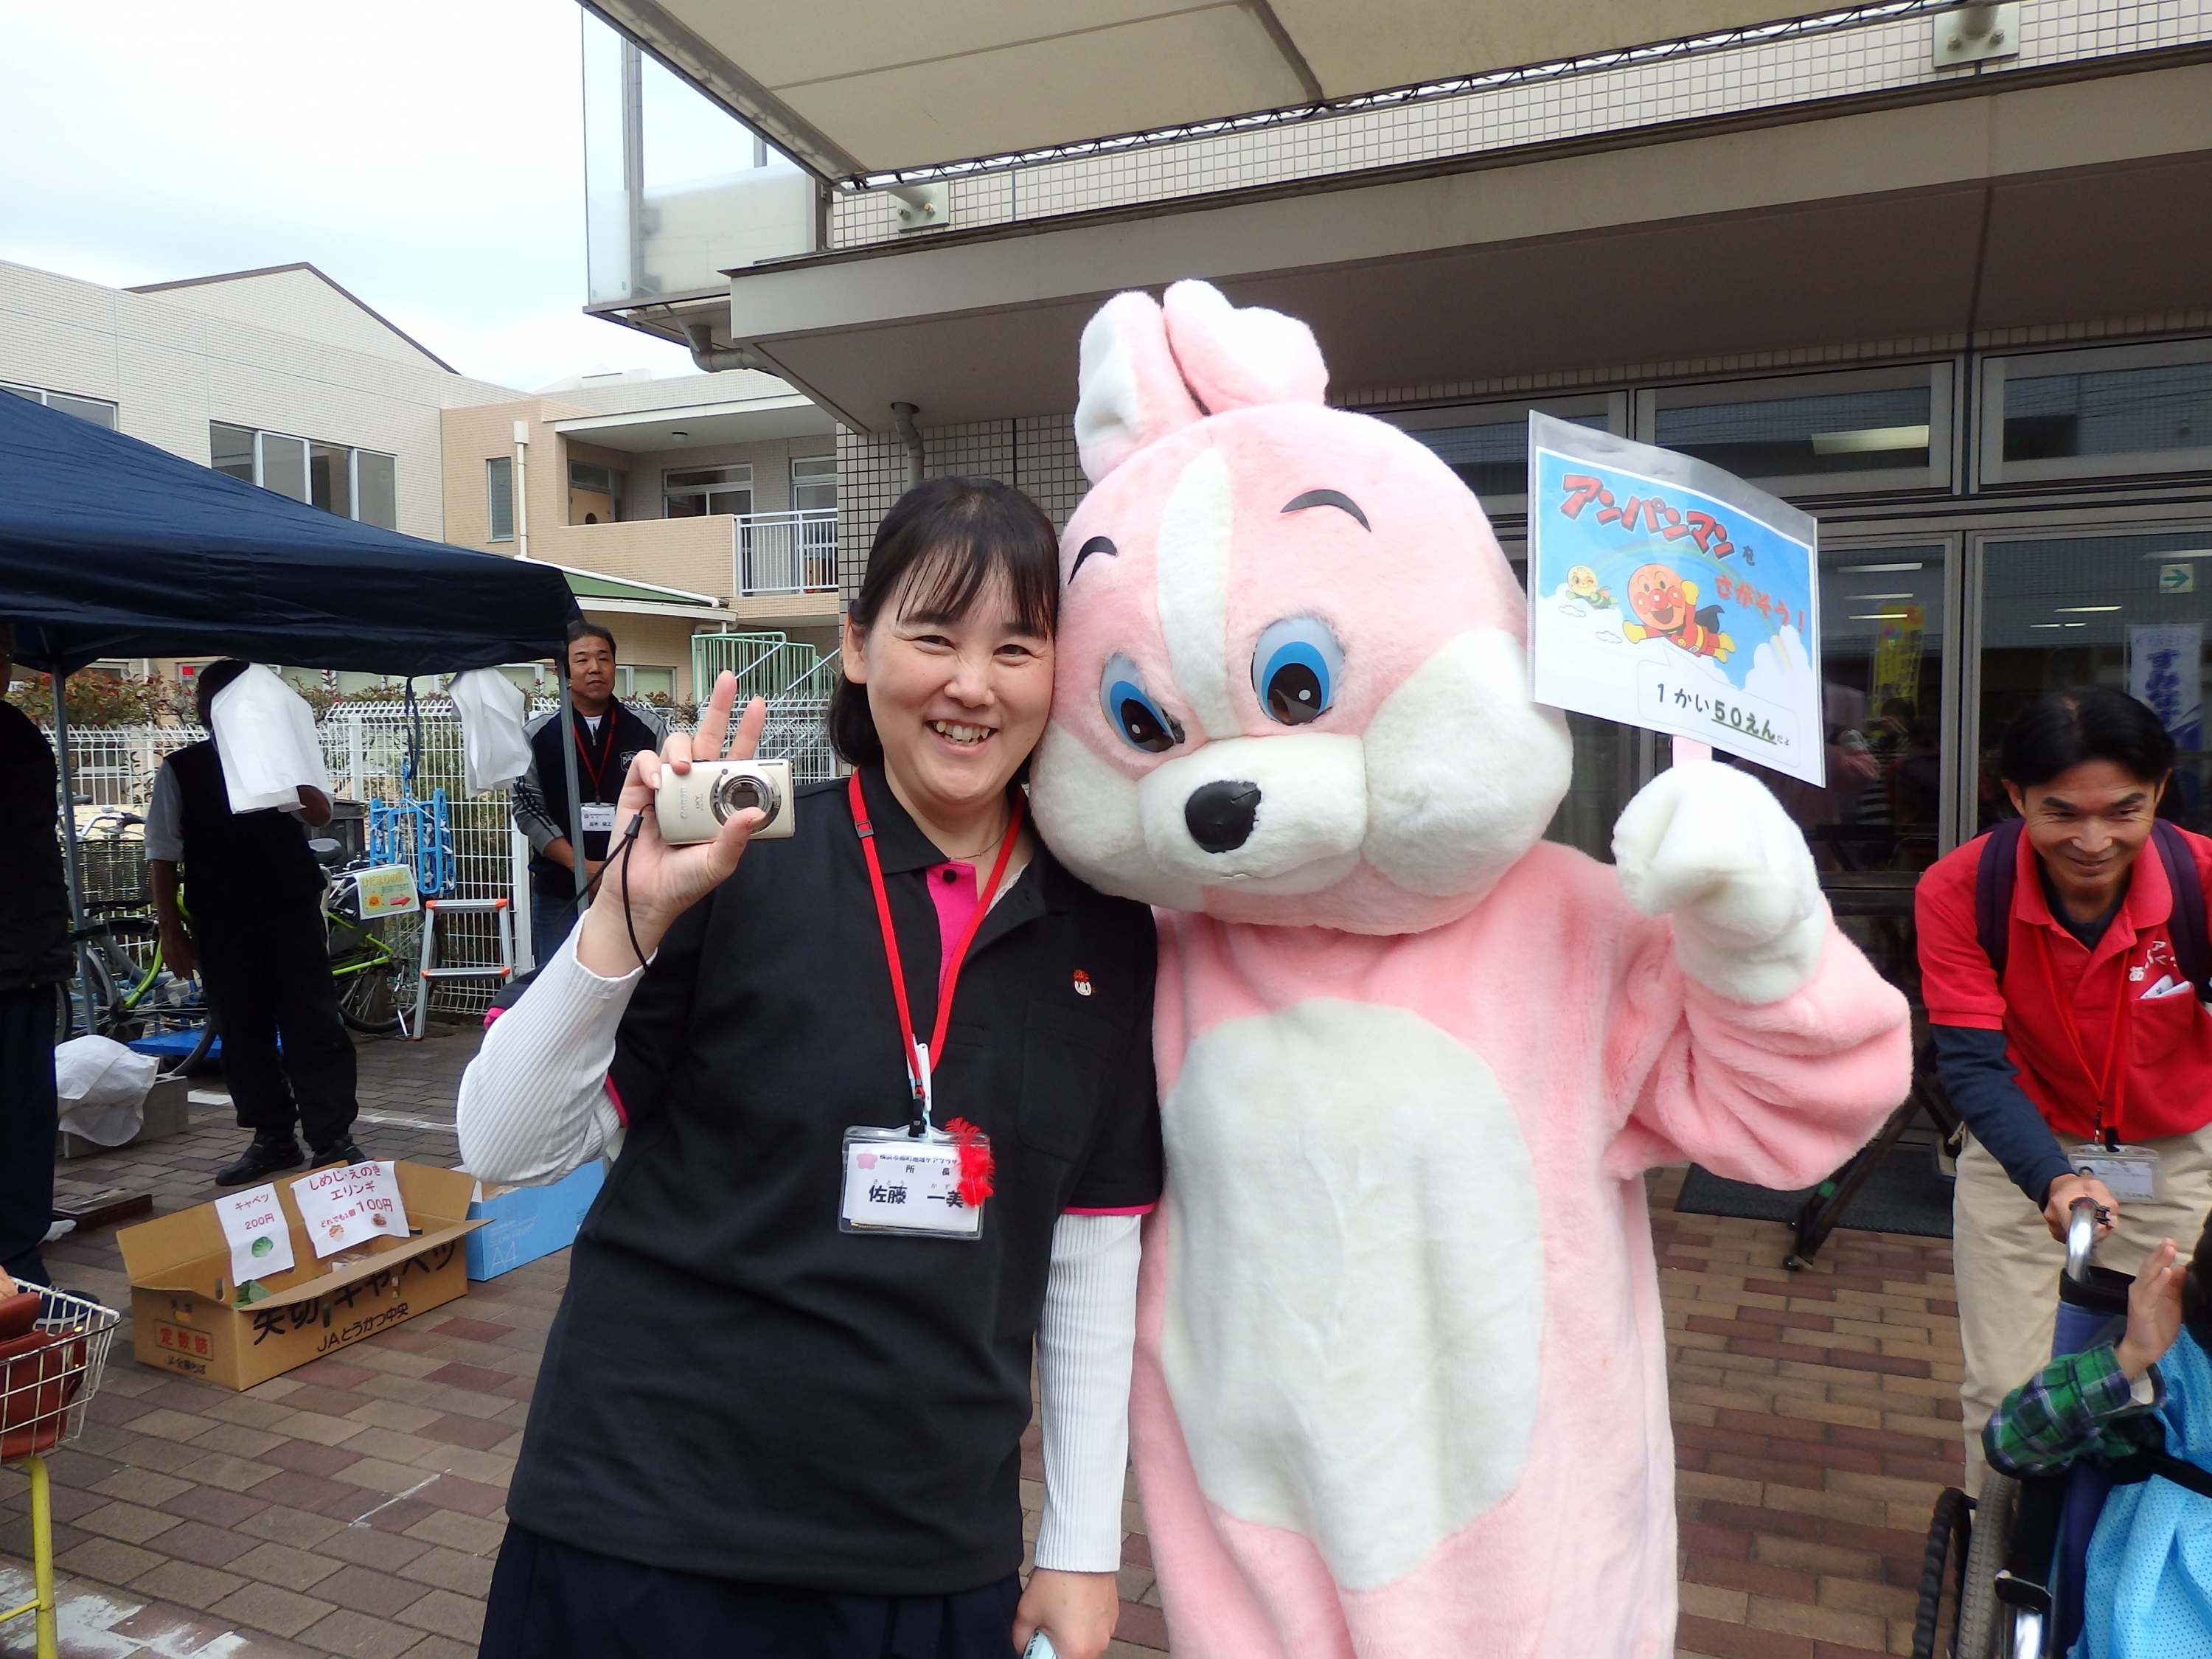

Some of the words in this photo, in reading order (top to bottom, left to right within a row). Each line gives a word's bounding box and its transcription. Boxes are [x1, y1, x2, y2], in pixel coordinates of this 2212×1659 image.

[680, 787, 688, 819] Canon
[330, 1180, 375, 1201] エリンギ
[869, 1184, 908, 1204] 佐藤
[235, 1194, 268, 1211] キャベツ
[356, 1198, 393, 1212] 100円
[245, 1213, 275, 1230] 200円
[490, 1240, 518, 1275] A4
[317, 1301, 409, 1352] JAとうかつ中央
